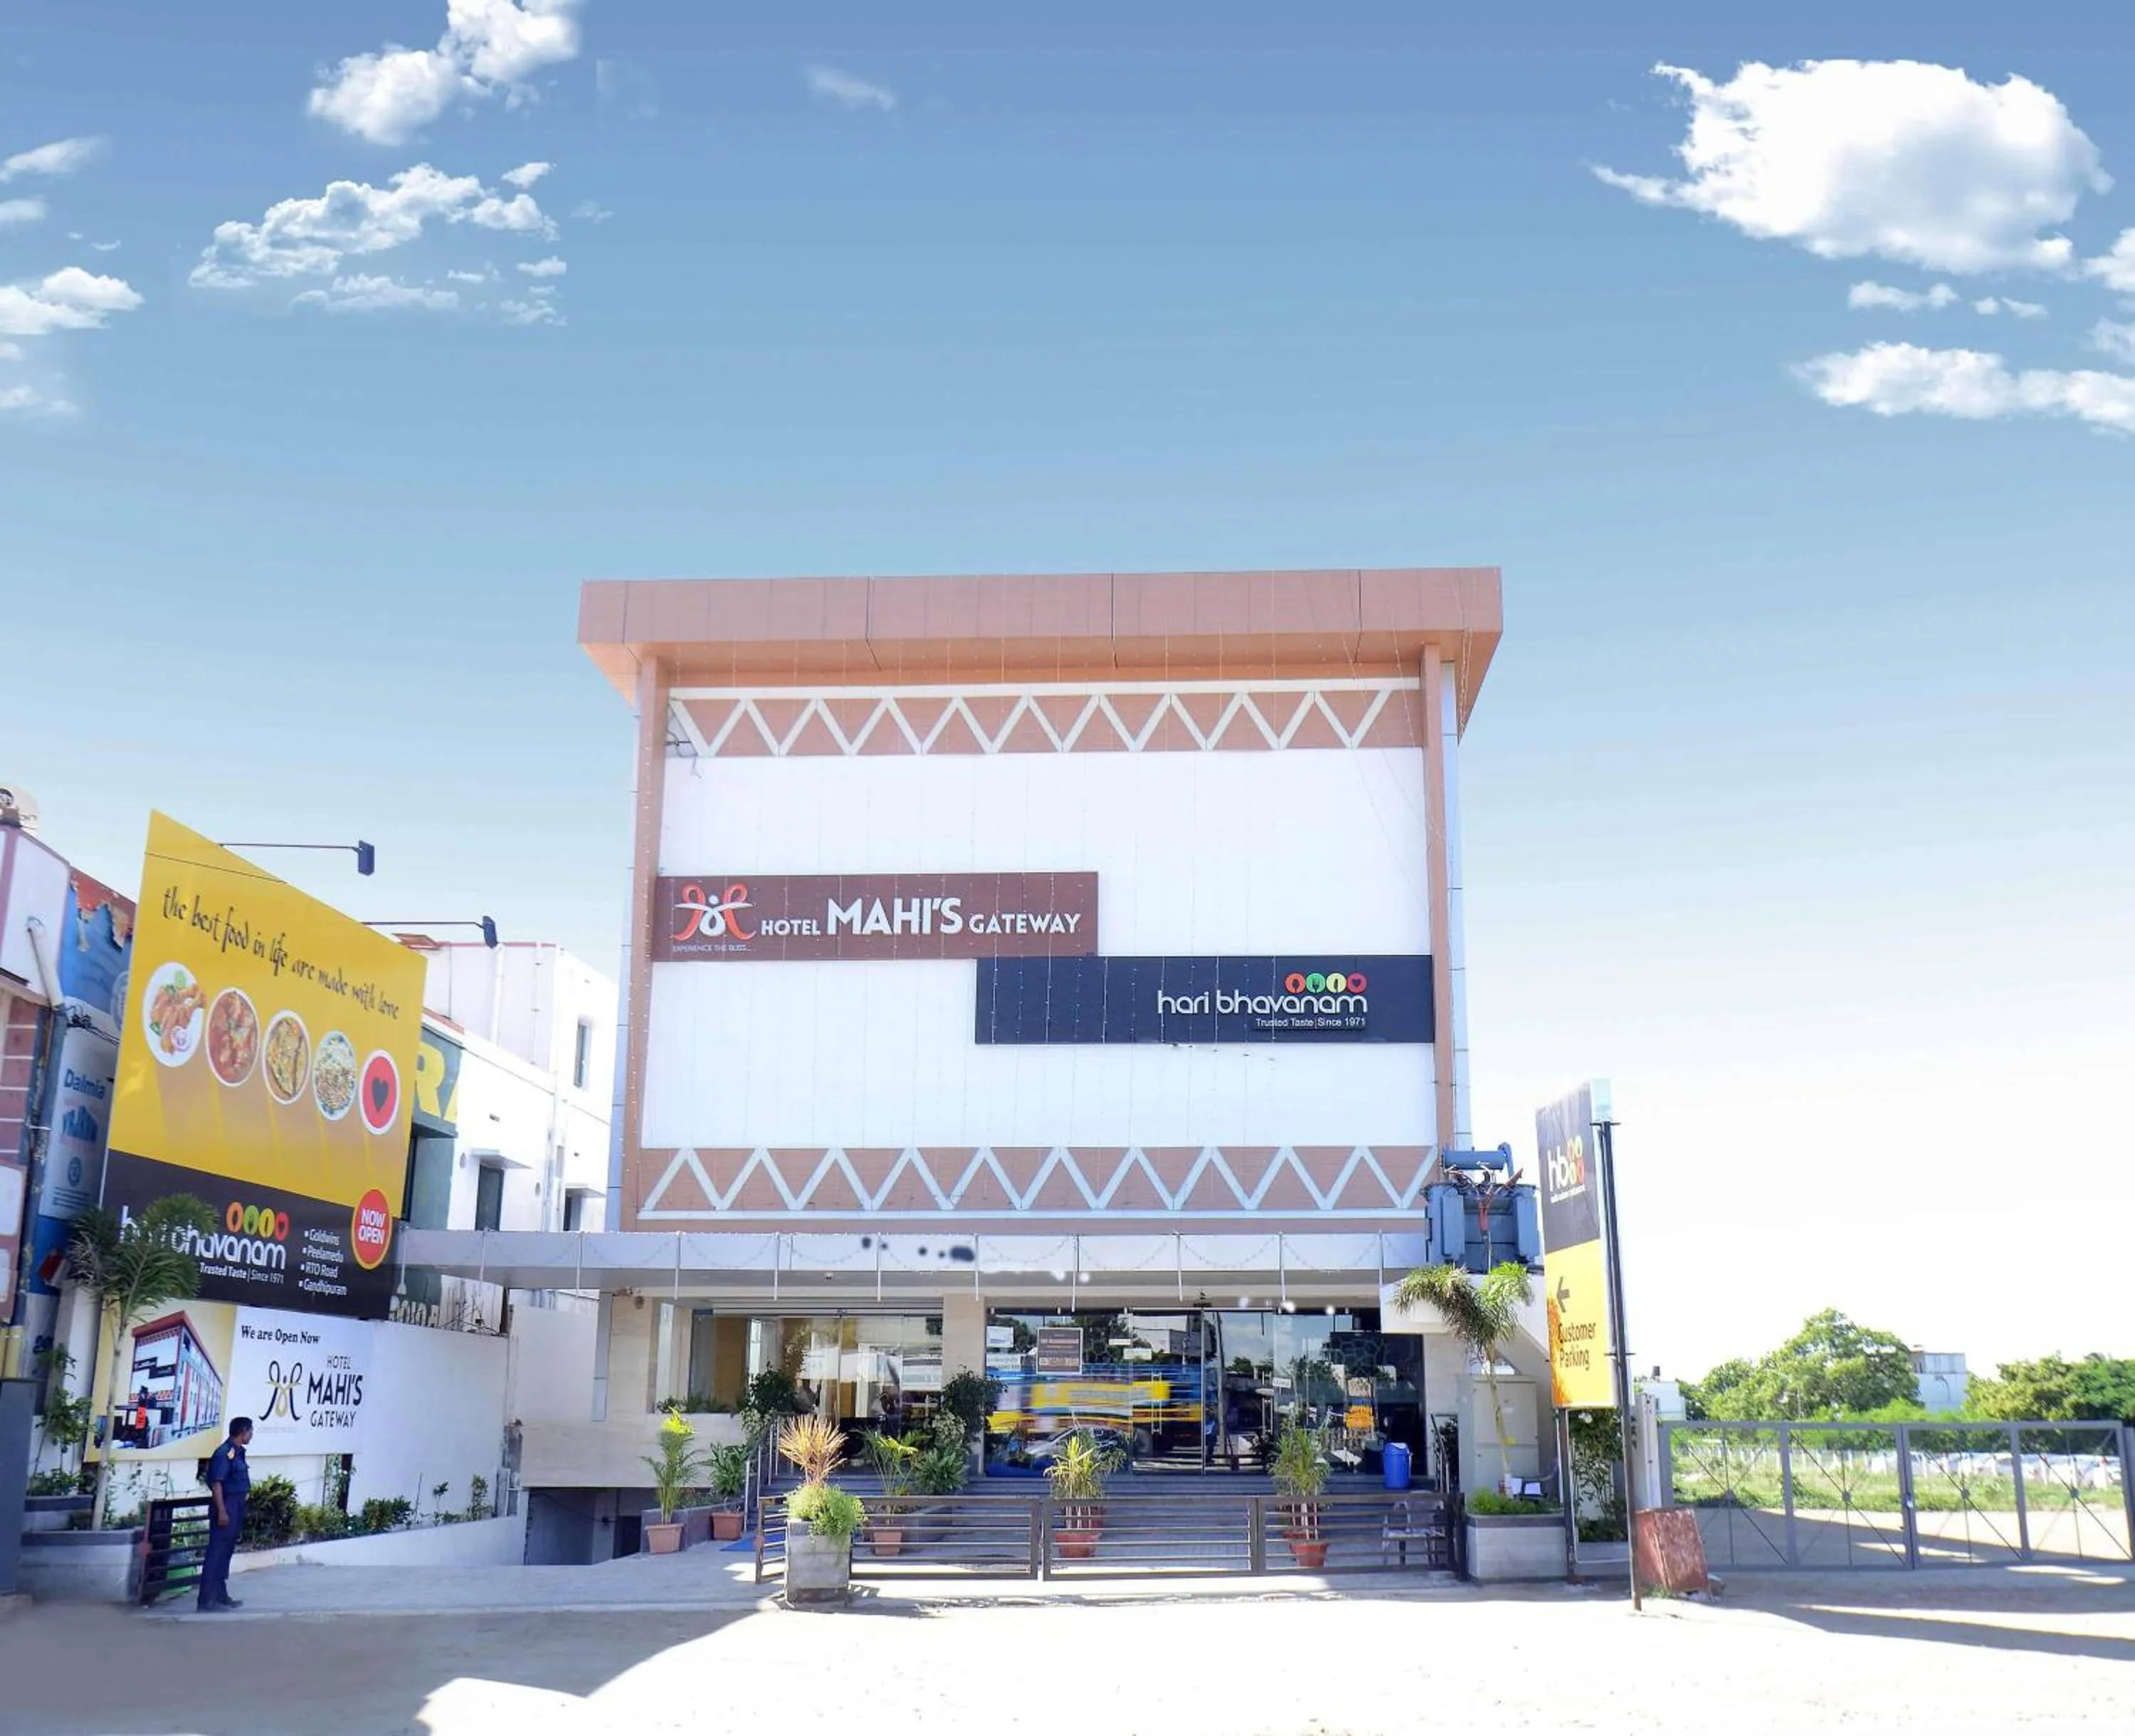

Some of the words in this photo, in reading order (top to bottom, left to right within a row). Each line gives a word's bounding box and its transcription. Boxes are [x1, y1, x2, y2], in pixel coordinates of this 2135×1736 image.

[761, 919, 821, 936] HOTEL
[827, 897, 964, 935] MAHI'S
[969, 913, 1081, 934] GATEWAY
[163, 886, 187, 920] the
[191, 894, 221, 942] best
[221, 906, 248, 953] food
[253, 931, 265, 958] in
[270, 932, 288, 976] life
[292, 959, 315, 980] are
[318, 967, 348, 995] made
[352, 983, 375, 1010] with
[378, 990, 399, 1020] love
[1158, 990, 1209, 1014] hari
[1216, 990, 1368, 1014] bhavanam
[1255, 1018, 1288, 1027] Trusted
[1317, 1017, 1341, 1027] Since
[1344, 1017, 1366, 1026] 1971
[64, 1069, 106, 1099] Dalmia
[361, 1208, 386, 1228] NOW
[358, 1224, 385, 1245] OPEN
[200, 1261, 227, 1276] Trusted
[228, 1266, 247, 1279] Taste
[251, 1270, 270, 1281] Since
[270, 1272, 285, 1284] 1971
[305, 1261, 320, 1276] RTO
[320, 1264, 339, 1279] Road
[303, 1279, 347, 1296] Gandhipuram
[241, 1325, 255, 1339] We
[257, 1330, 273, 1340] are
[275, 1328, 298, 1345] Open
[300, 1331, 321, 1344] Now
[1558, 1322, 1596, 1343] Customer
[327, 1355, 352, 1370] HOTEL
[1559, 1344, 1590, 1371] Parking
[307, 1371, 364, 1406] MAHI'S
[310, 1409, 357, 1428] GATEWAY
